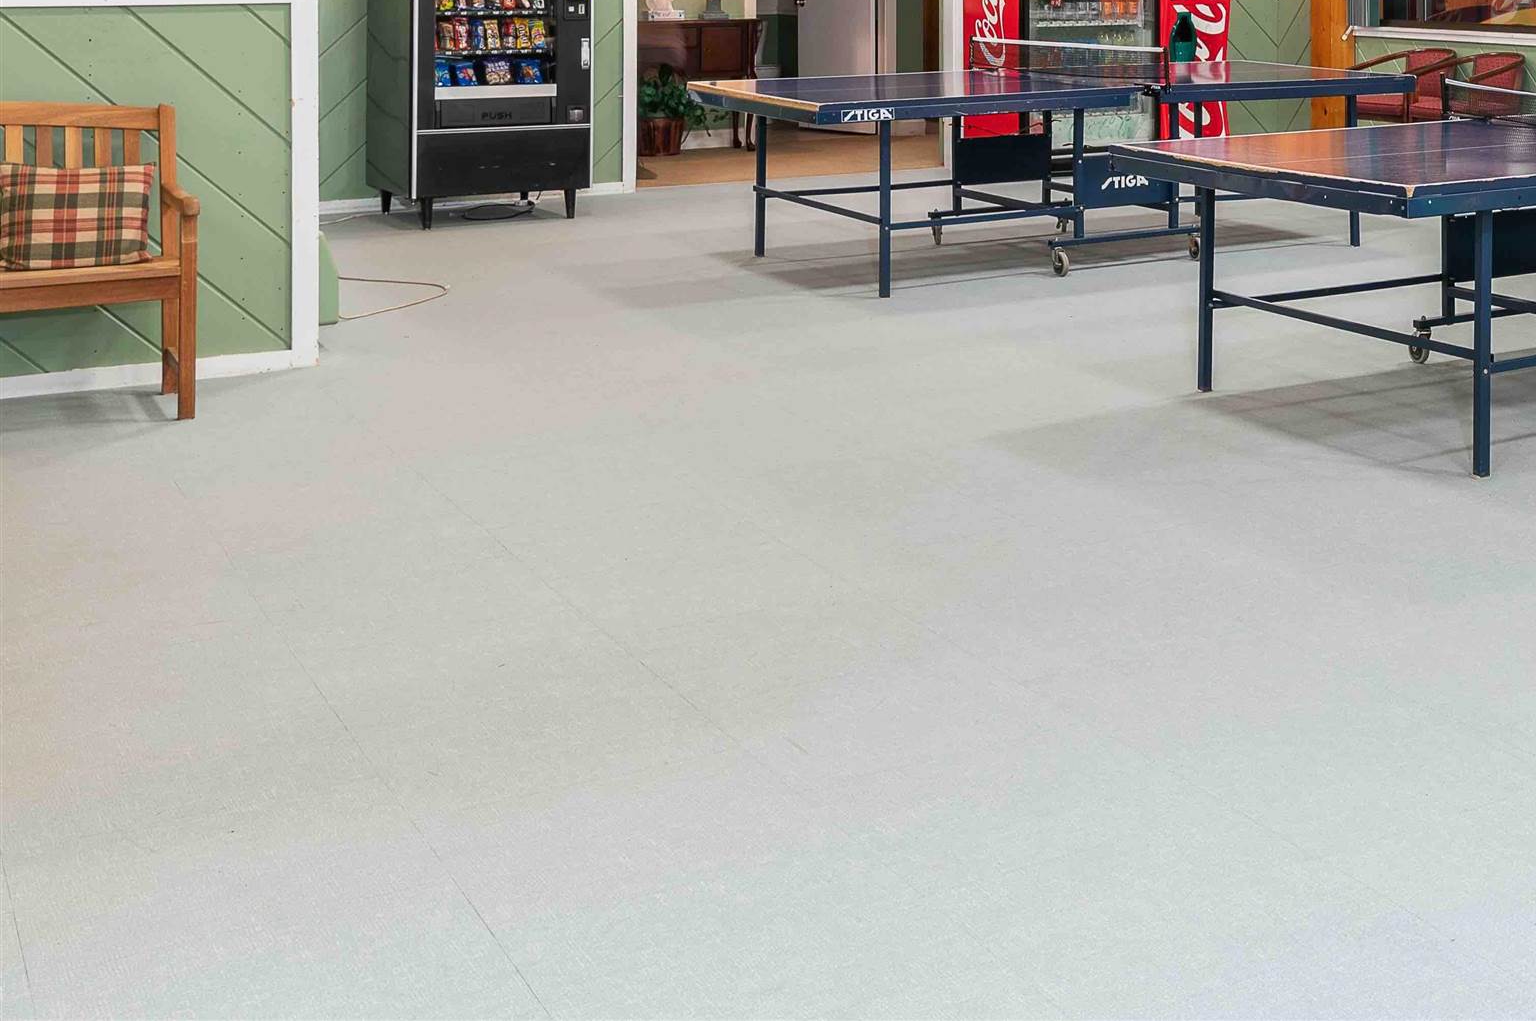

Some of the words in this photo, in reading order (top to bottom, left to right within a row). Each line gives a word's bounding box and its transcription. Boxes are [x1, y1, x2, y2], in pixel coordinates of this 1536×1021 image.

[481, 112, 512, 120] PUSH
[843, 108, 893, 122] STIGA
[1101, 175, 1149, 190] STIGA
